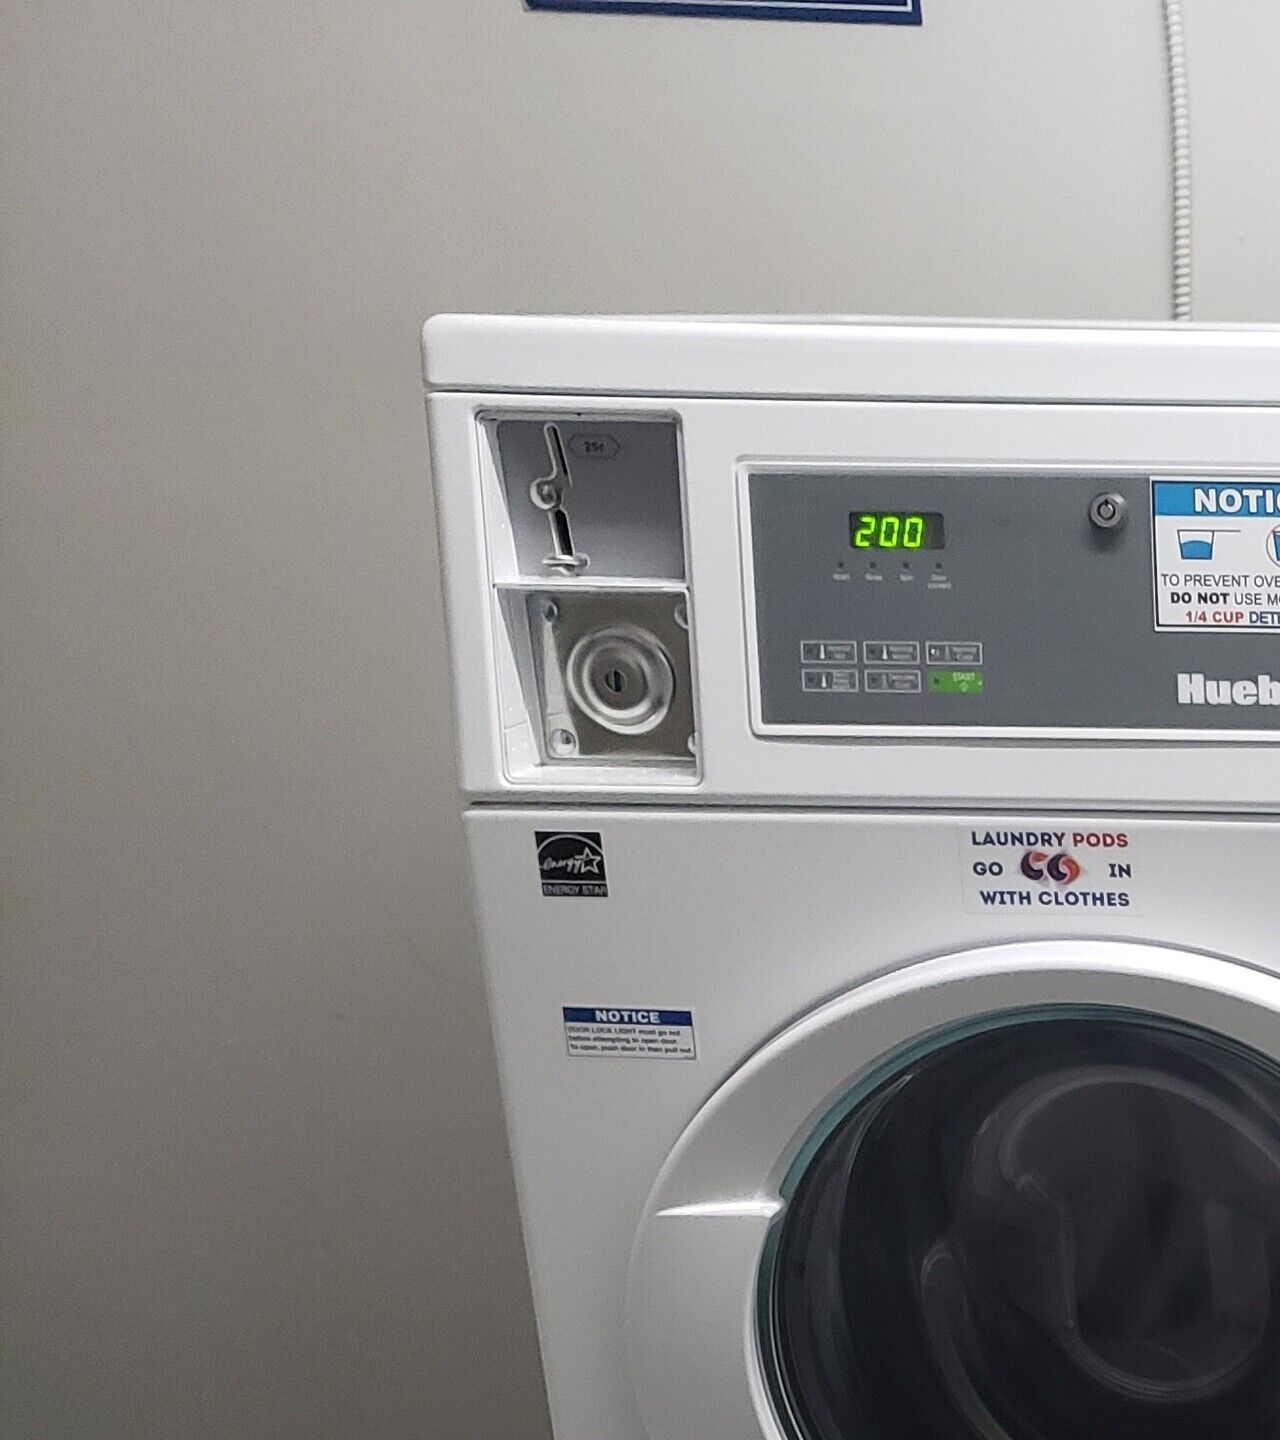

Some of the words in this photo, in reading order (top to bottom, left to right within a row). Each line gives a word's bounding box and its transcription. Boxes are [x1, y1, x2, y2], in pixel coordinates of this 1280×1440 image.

[855, 516, 924, 547] 200
[1161, 573, 1179, 587] TO
[1184, 574, 1249, 588] PREVENT
[1171, 592, 1192, 604] DO
[1197, 592, 1230, 605] NOT
[1235, 593, 1262, 605] USE
[1185, 611, 1207, 623] 1/4
[1212, 611, 1244, 623] CUP
[972, 831, 1065, 847] LAUNDRY
[1073, 833, 1128, 848] PODS
[973, 862, 1003, 876] GO
[1109, 863, 1131, 878] IN
[979, 891, 1031, 905] WITH
[1038, 891, 1129, 907] CLOTHES
[595, 1010, 660, 1023] NOTICE
